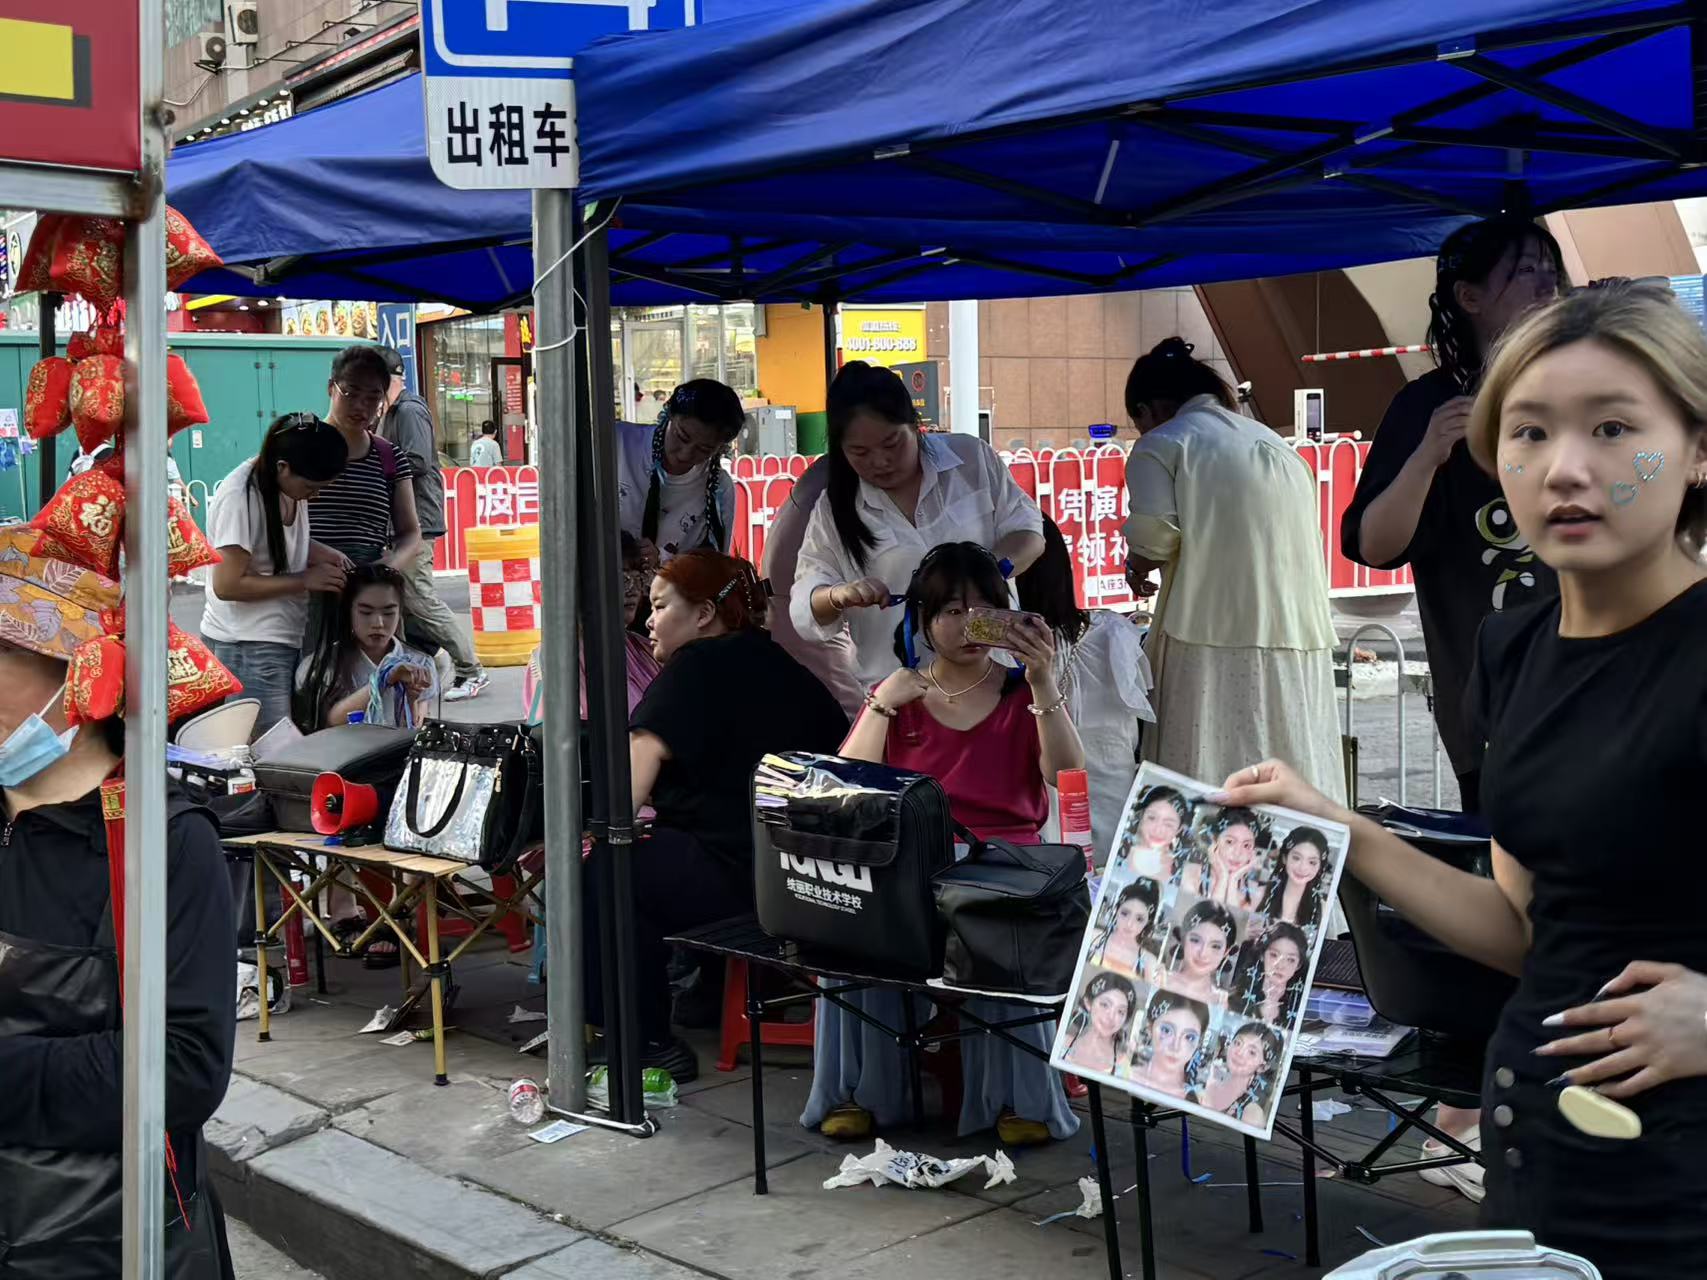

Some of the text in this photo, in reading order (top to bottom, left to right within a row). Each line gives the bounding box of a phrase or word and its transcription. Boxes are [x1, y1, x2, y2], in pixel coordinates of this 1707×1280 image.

[447, 101, 570, 167] 出租车
[380, 311, 411, 350] 入口
